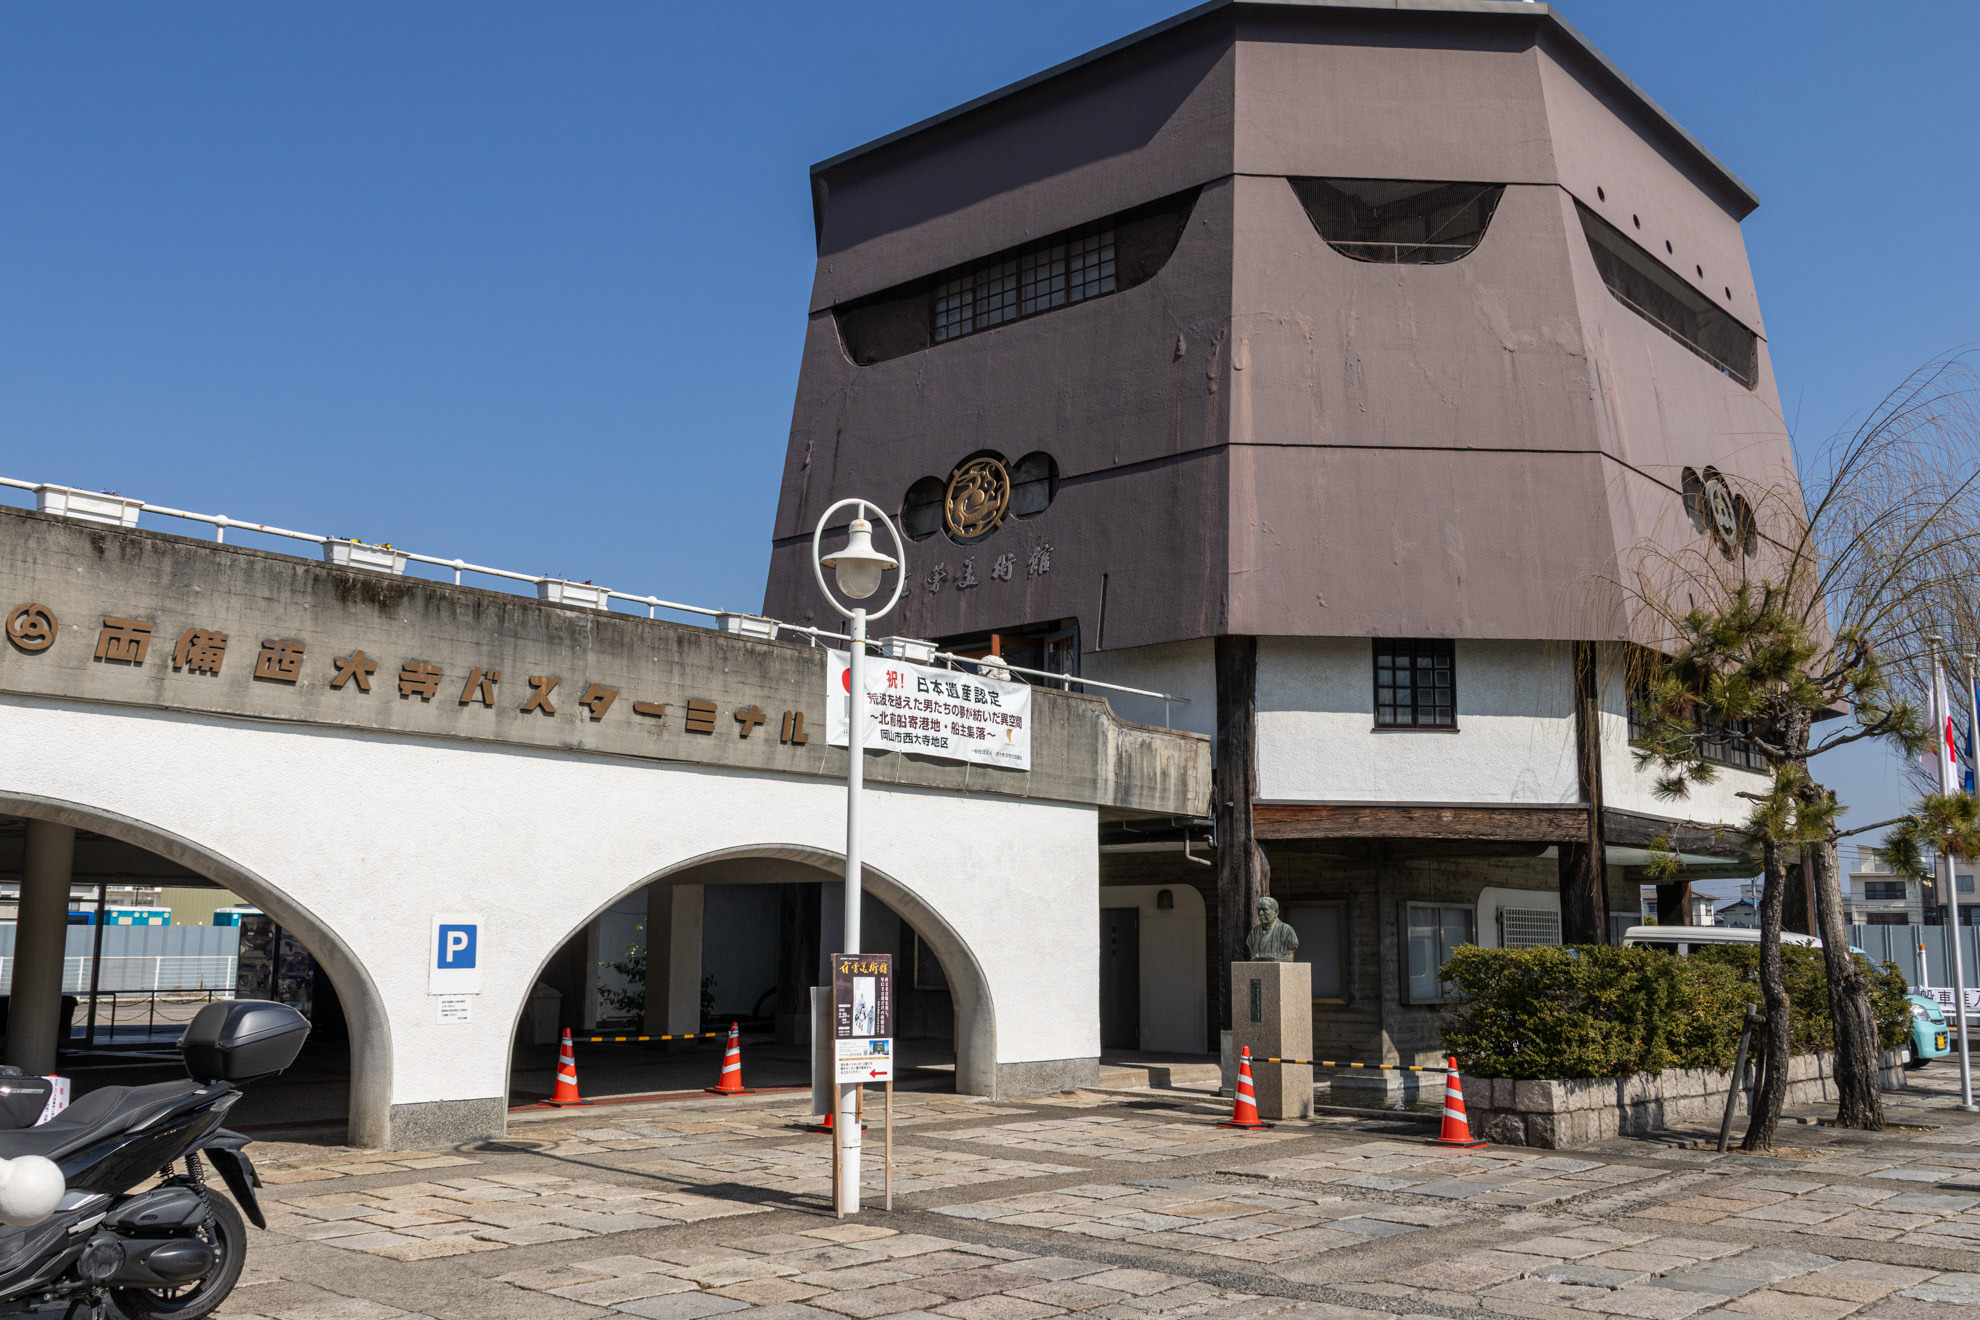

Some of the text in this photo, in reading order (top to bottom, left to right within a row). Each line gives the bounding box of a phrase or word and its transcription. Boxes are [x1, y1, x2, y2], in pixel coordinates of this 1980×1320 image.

[94, 616, 809, 744] 両備西大寺バスターミナル
[917, 676, 1002, 708] 日本遺産認定
[866, 692, 1023, 730] 荒波を越えた男たちの夢が紡いだ異空間
[880, 729, 949, 749] 岡山市西大寺地区
[446, 931, 469, 963] P
